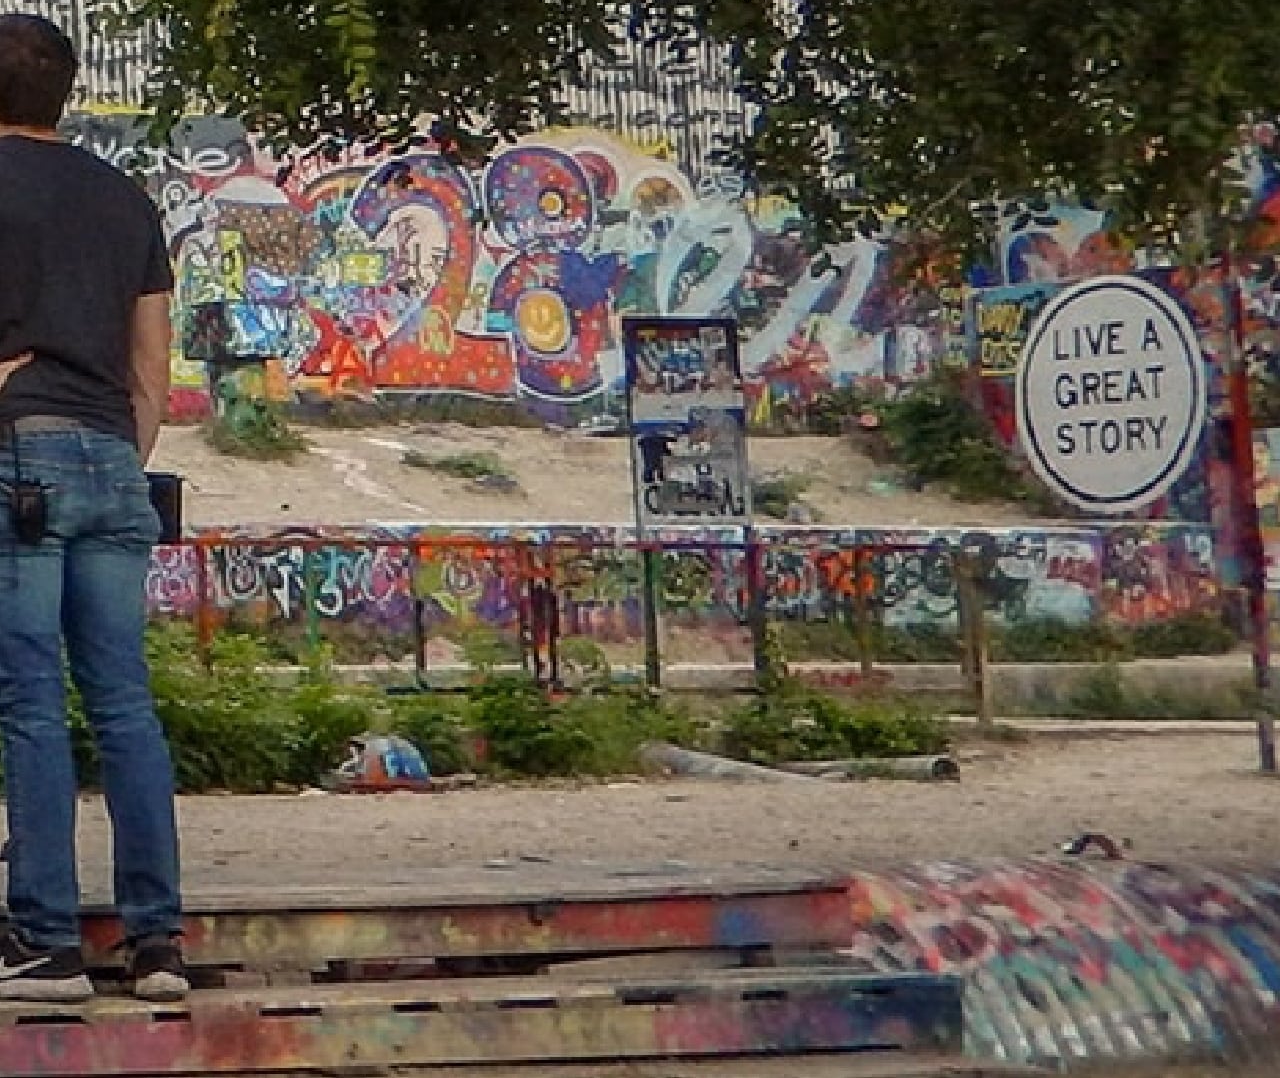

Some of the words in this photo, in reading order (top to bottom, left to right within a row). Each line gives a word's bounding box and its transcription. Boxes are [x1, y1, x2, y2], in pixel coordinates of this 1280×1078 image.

[1052, 320, 1127, 361] LIVE
[1143, 318, 1163, 352] A
[1055, 364, 1166, 409] GREAT
[1057, 416, 1168, 454] STORY
